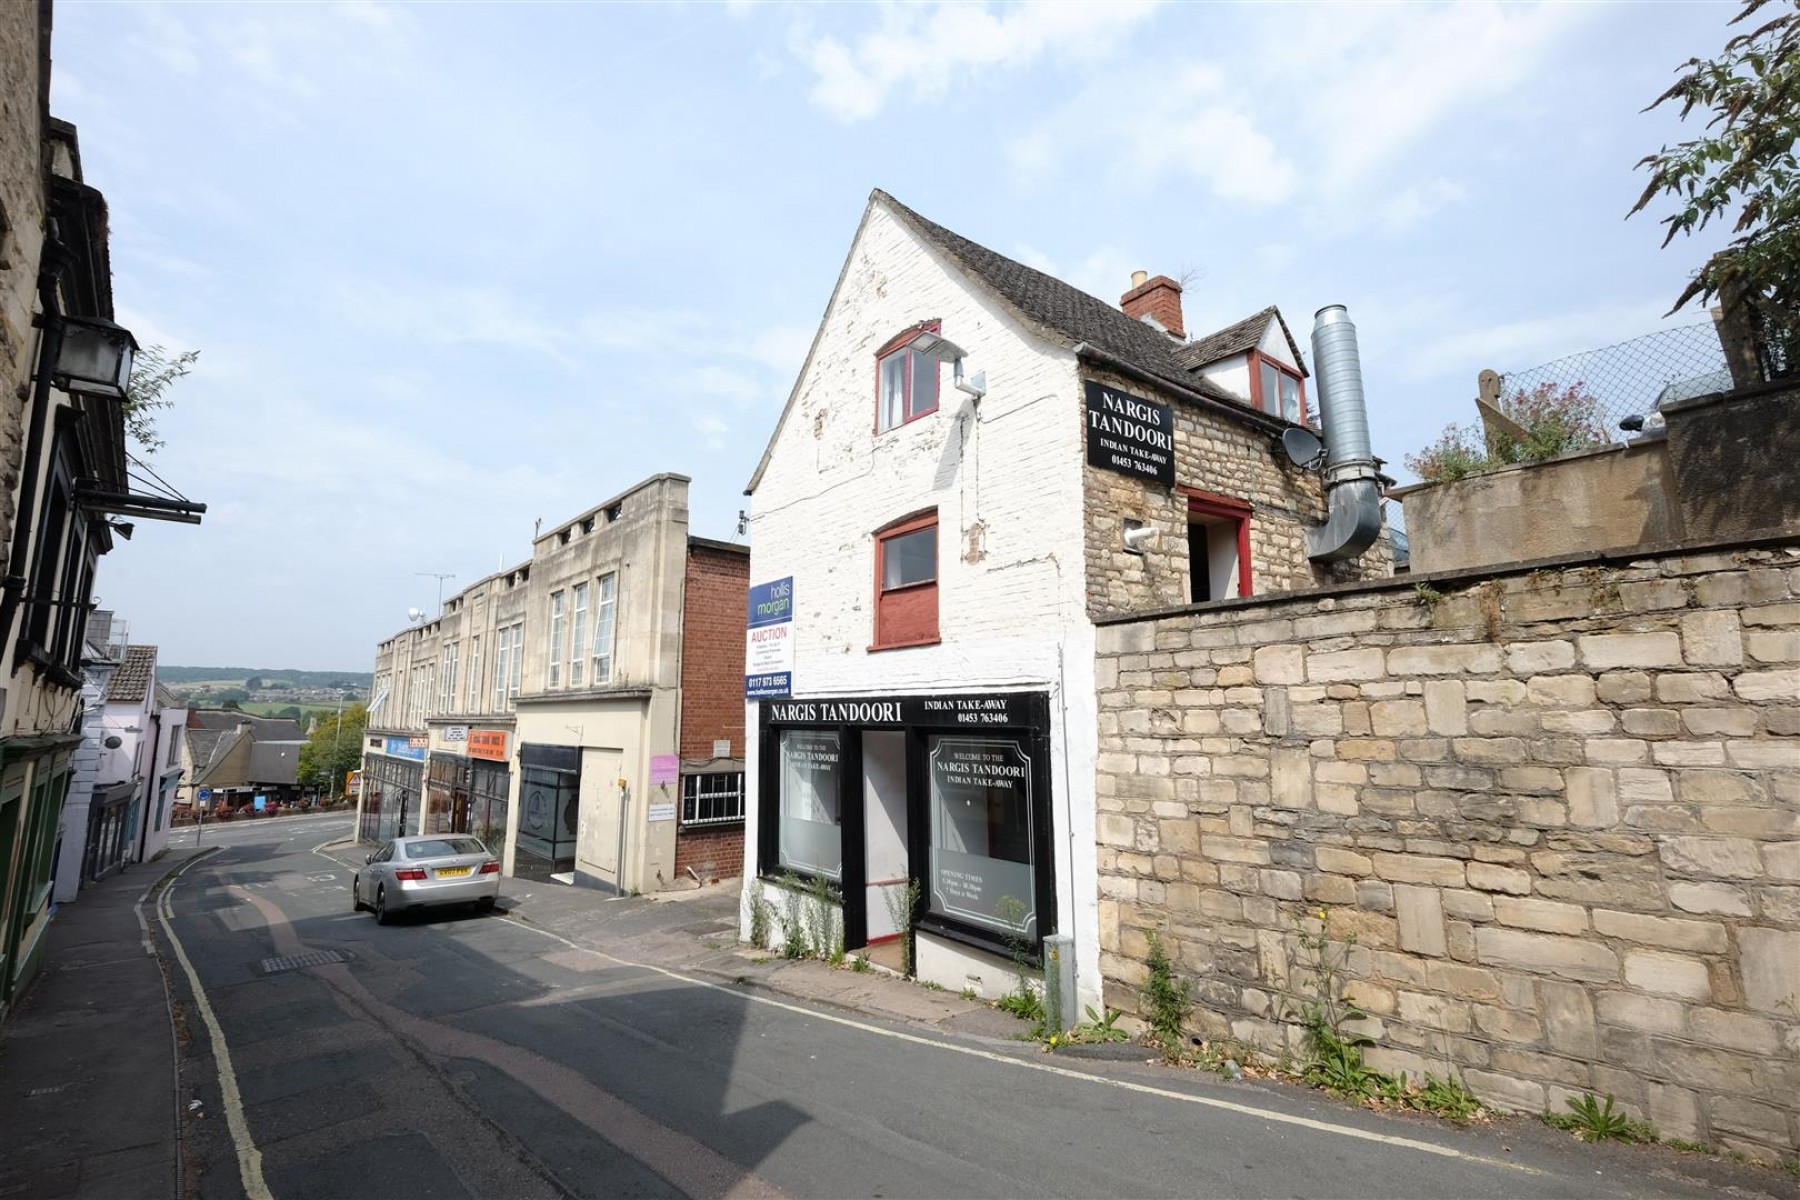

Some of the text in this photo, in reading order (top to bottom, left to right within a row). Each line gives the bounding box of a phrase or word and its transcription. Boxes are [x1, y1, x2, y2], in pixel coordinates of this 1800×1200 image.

[1102, 392, 1160, 425] NARGIS
[1089, 410, 1172, 451] TANDOORI
[1100, 438, 1128, 452] INDIAN
[1111, 454, 1132, 468] 01453
[770, 581, 790, 600] hollis
[757, 598, 790, 616] morgan
[751, 626, 788, 643] AUCTION
[771, 702, 902, 721] NARGIS TANDOORI
[924, 700, 1008, 710] INDIAN TAKE-AWAY
[957, 712, 1009, 723] 01453 763406
[807, 752, 839, 762] TANDOORI
[953, 752, 981, 761] WELCOME
[991, 754, 1004, 762] THE
[937, 761, 1025, 777] NARGIS TANDOORI
[947, 775, 1013, 788] INDIAN TAKE-AWAY
